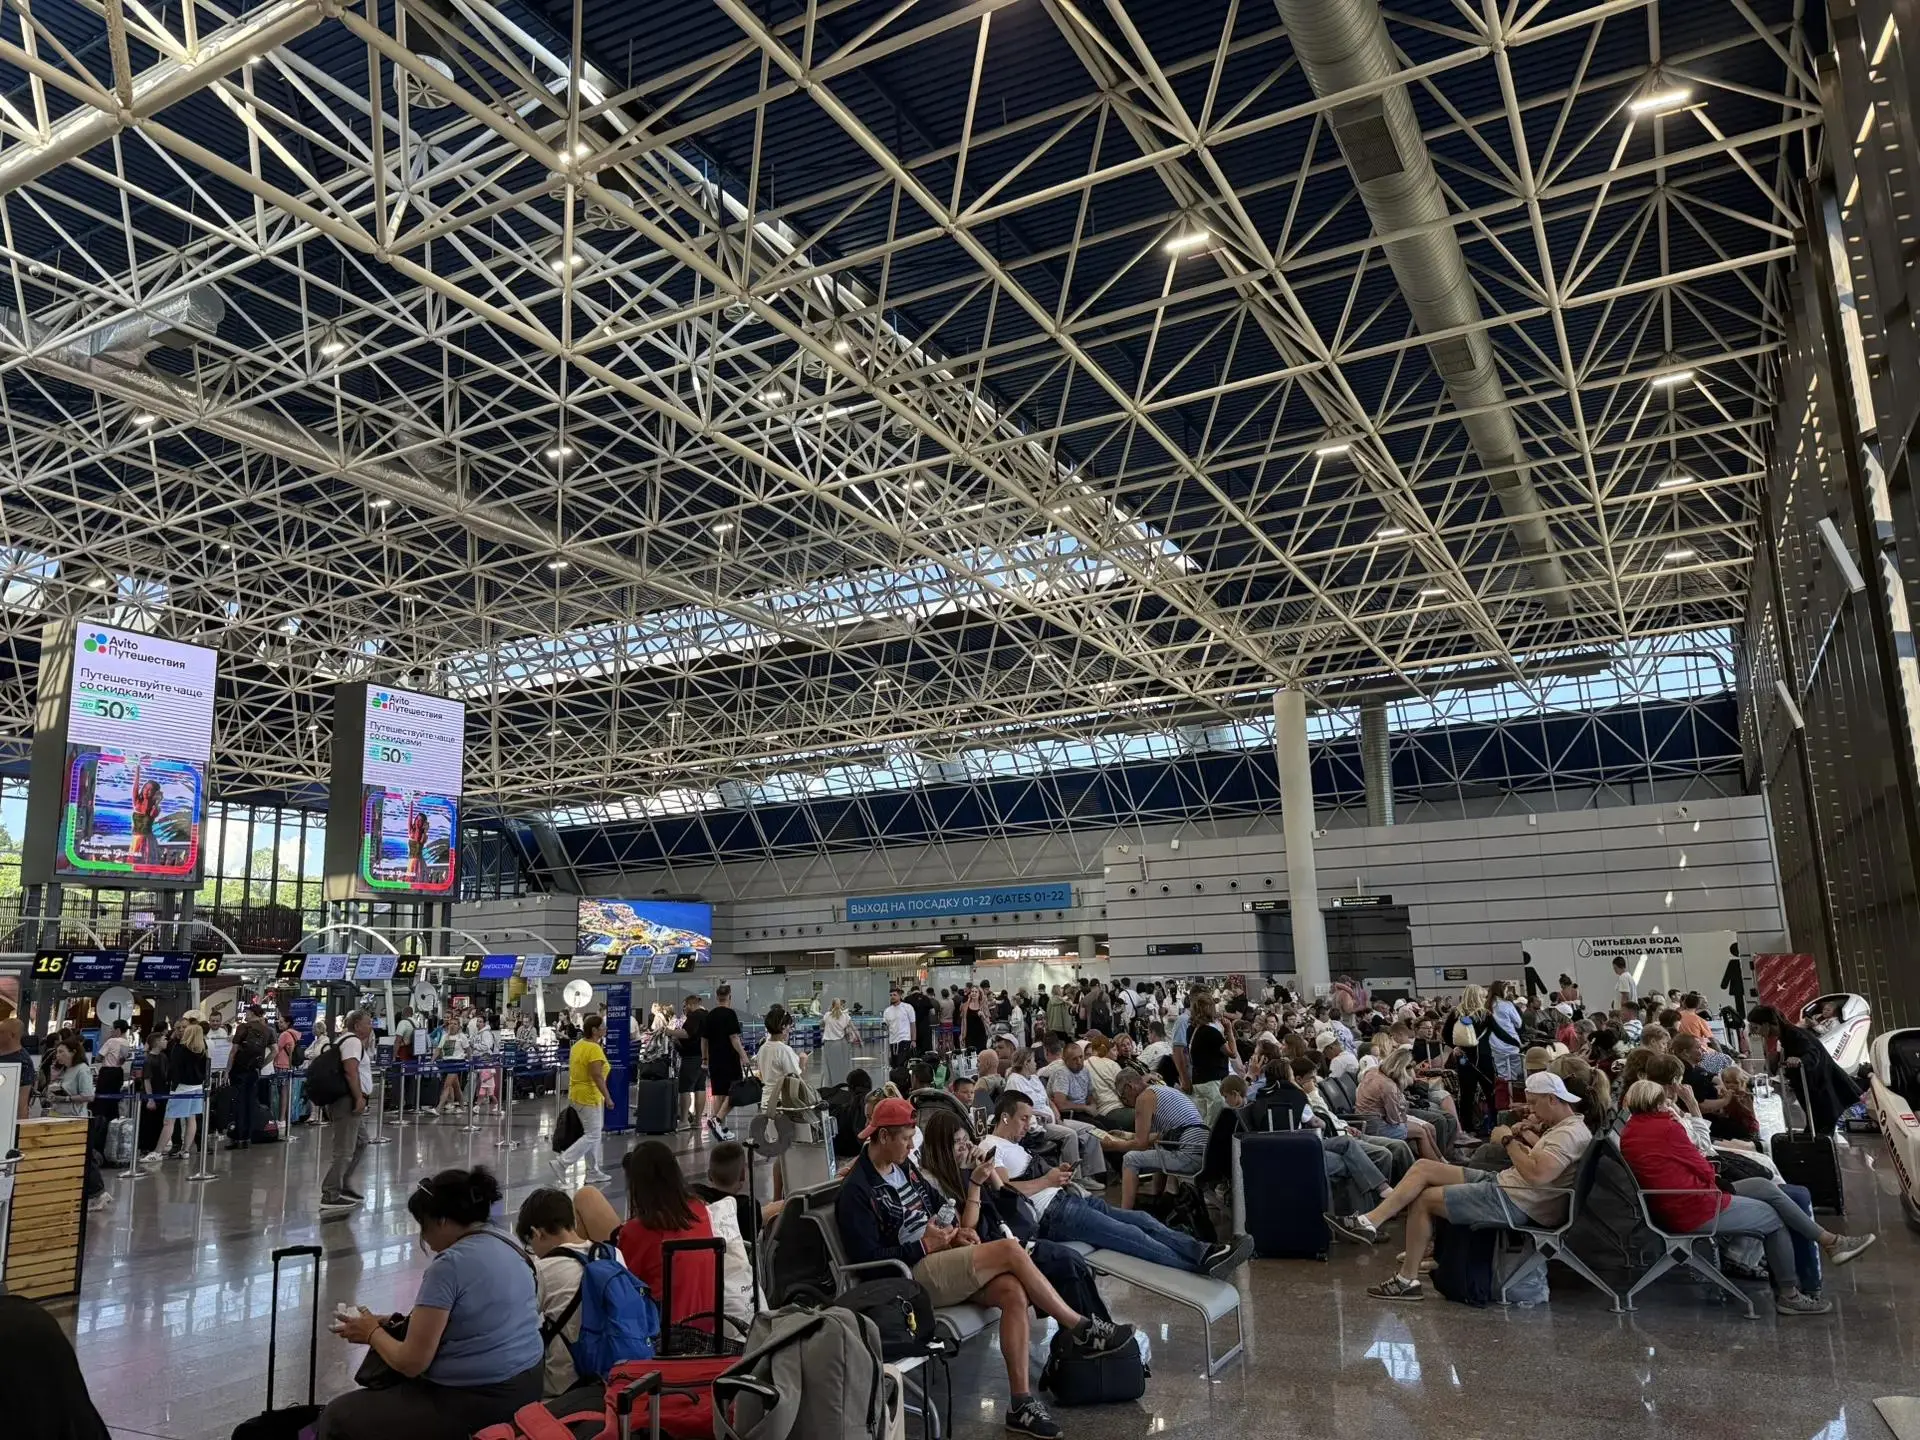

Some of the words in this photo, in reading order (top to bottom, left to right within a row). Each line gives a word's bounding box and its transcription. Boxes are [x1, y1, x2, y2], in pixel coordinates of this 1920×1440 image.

[109, 636, 138, 650] Avito
[109, 646, 185, 669] Путешествия
[80, 667, 172, 692] Путешествуйте
[174, 684, 203, 698] чаще
[79, 681, 94, 690] со
[96, 683, 155, 700] скидками
[389, 694, 410, 706] Avito
[389, 702, 443, 720] Путешествия
[370, 721, 434, 740] Путешествуйте
[434, 734, 456, 744] чаще
[381, 734, 422, 746] скидками
[851, 903, 889, 914] ВЫХОД
[890, 902, 906, 912] НА
[908, 897, 960, 910] ПОСАДКУ
[1034, 890, 1064, 902] 01-22
[1592, 937, 1647, 946] ПИТЬЕВАЯ
[1649, 936, 1680, 944] ВОДА
[1593, 947, 1643, 956] DRINKING
[1645, 946, 1683, 954] WATER
[36, 957, 63, 972] 15
[196, 958, 218, 972] 16
[282, 959, 301, 972] 17
[399, 960, 417, 972] 18
[463, 960, 480, 972] 19
[555, 959, 569, 970] 20
[605, 960, 618, 970] 21
[677, 958, 688, 968] 22
[1093, 1338, 1105, 1350] N
